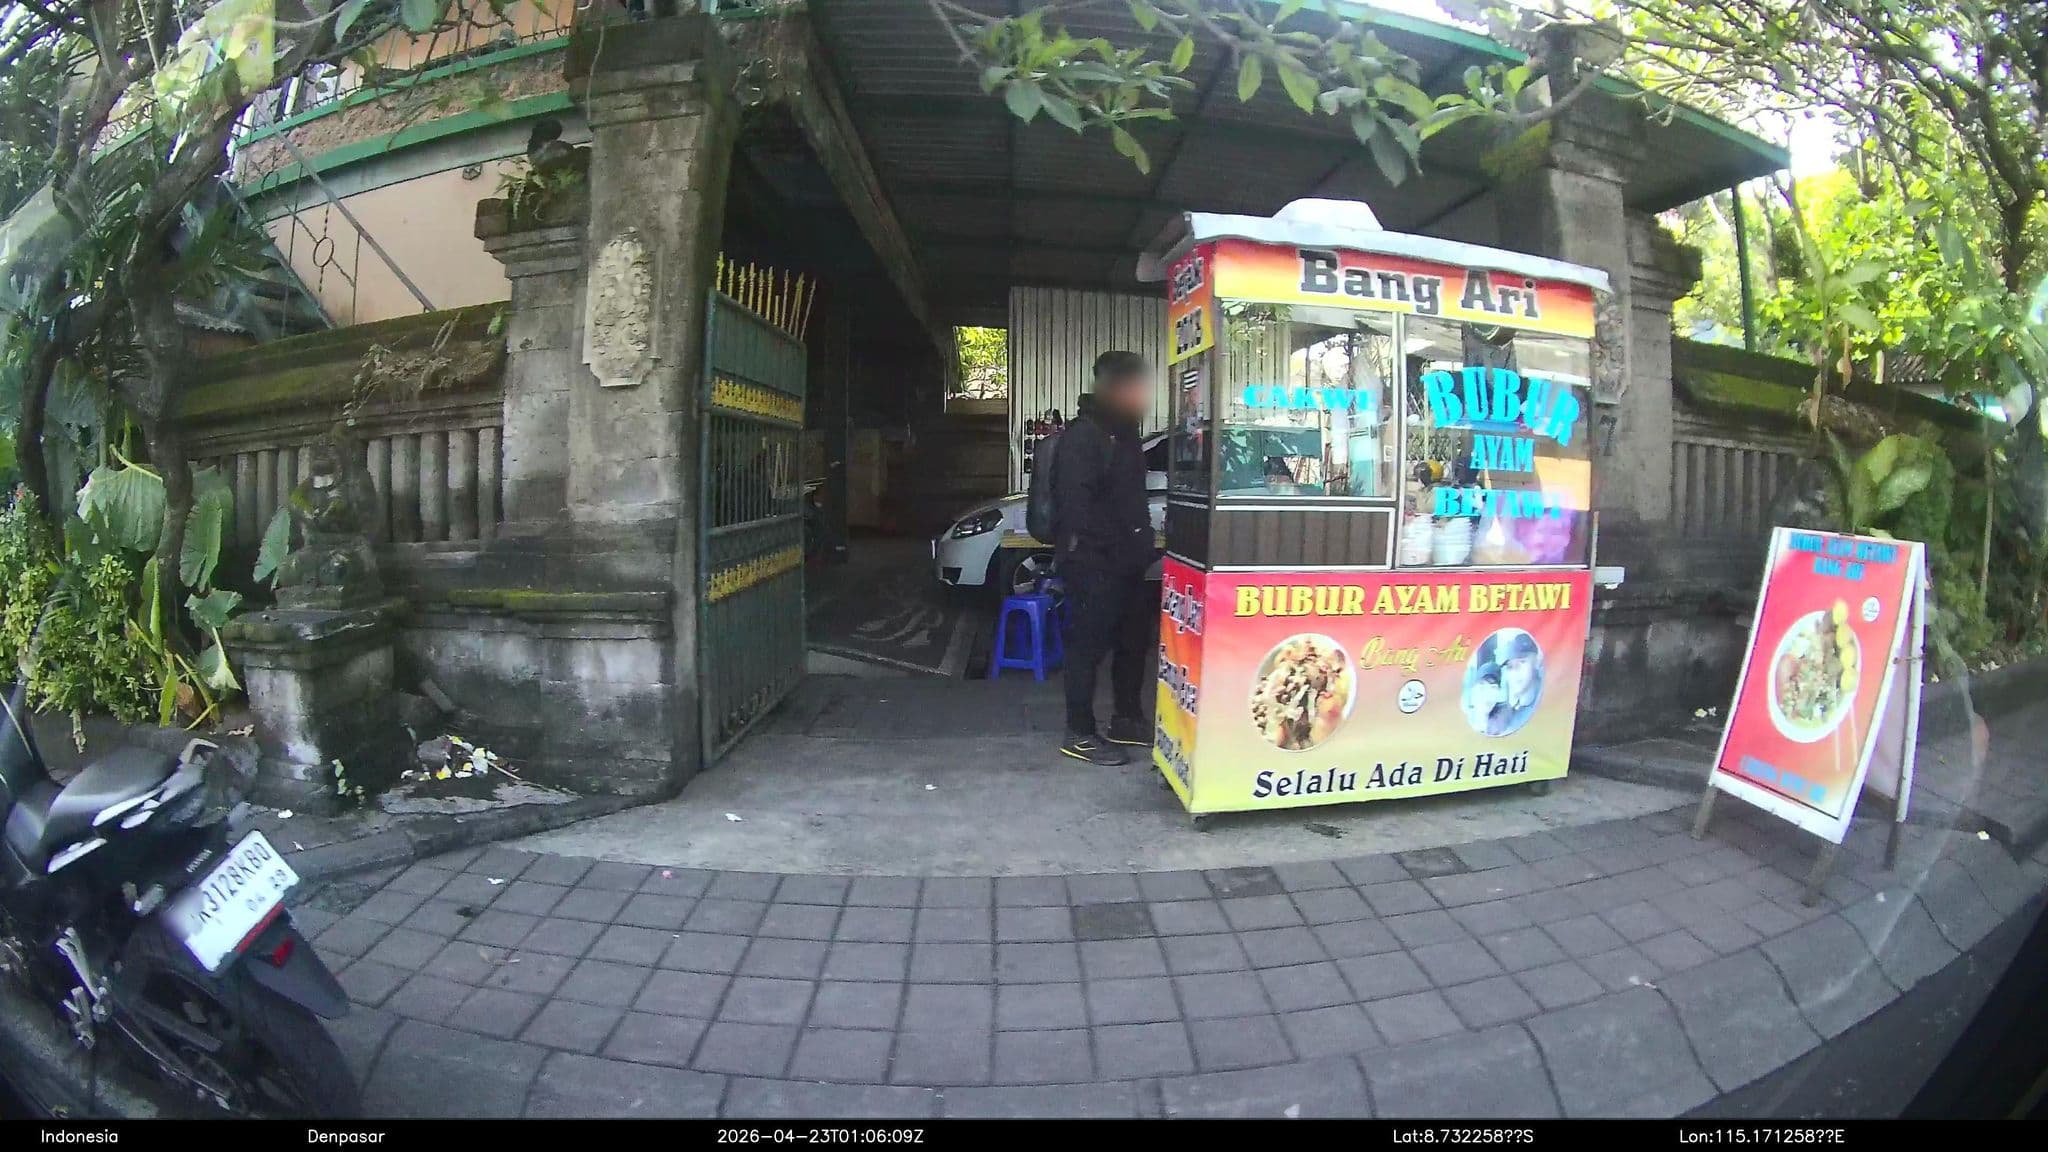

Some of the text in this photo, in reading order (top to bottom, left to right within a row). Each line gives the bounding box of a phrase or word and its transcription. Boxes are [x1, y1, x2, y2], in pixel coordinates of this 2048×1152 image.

[1299, 250, 1541, 319] Bang Ari
[1420, 366, 1581, 448] BUBUR
[1469, 434, 1535, 473] AYAM
[1433, 486, 1562, 520] BETAWI
[1234, 583, 1366, 618] BUBUR
[1371, 582, 1460, 615] AYAM
[1467, 582, 1572, 613] BETAWI
[1252, 749, 1530, 799] Selalu Ada Di Hati
